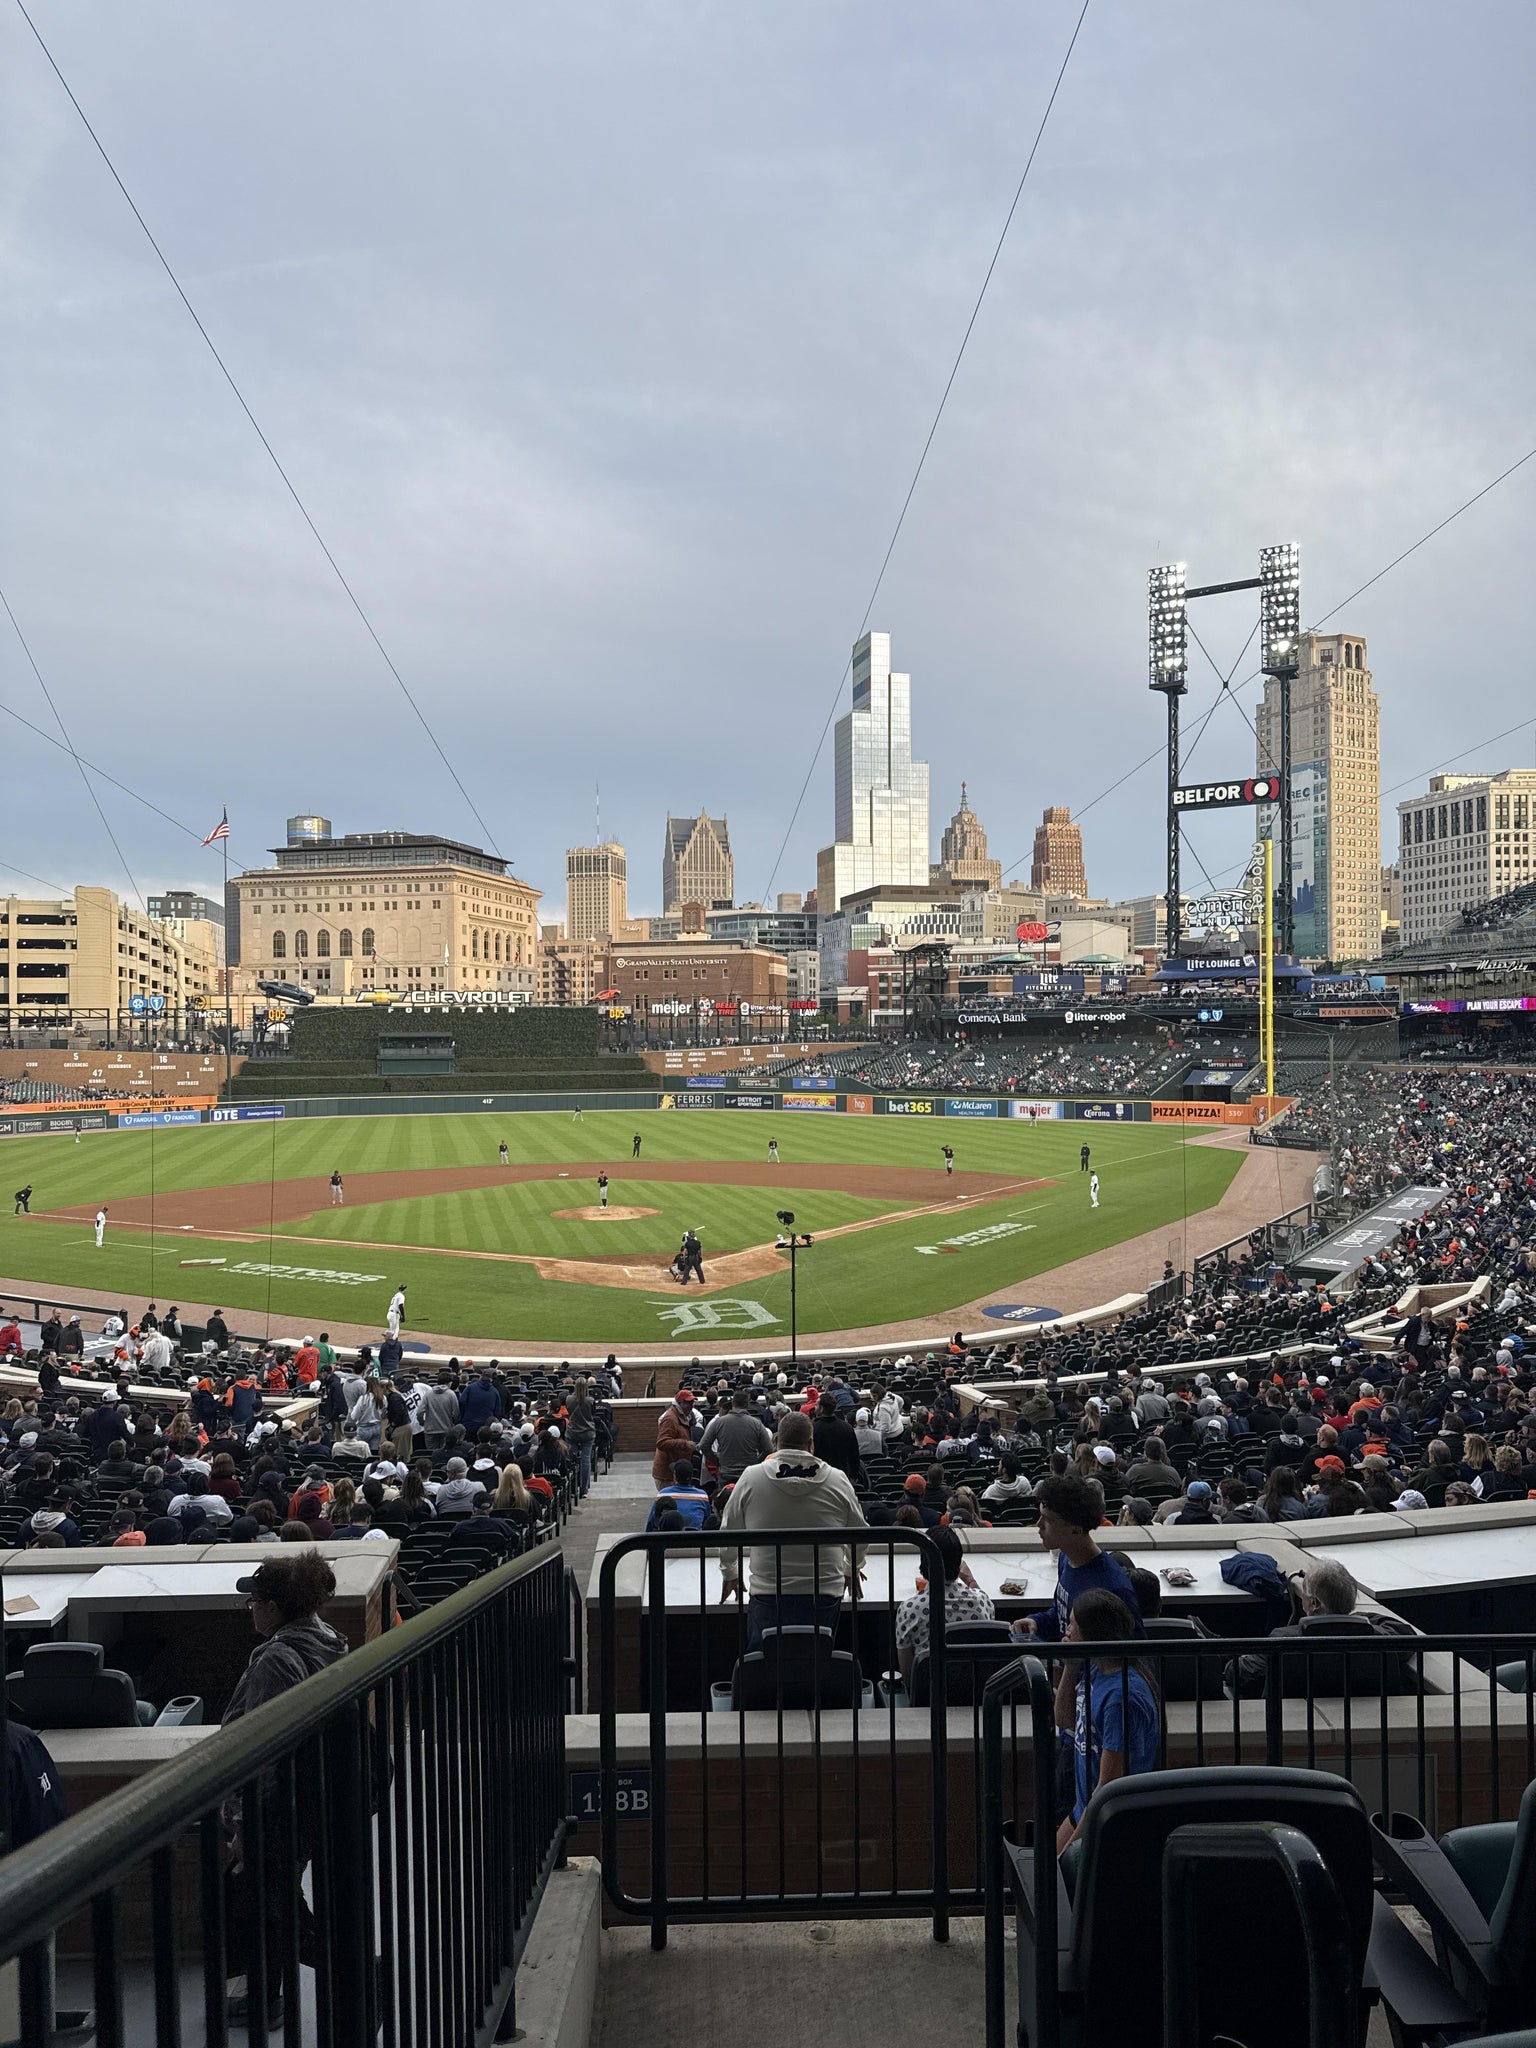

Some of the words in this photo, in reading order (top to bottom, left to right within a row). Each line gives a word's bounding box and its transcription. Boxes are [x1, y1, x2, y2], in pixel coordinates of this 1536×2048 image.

[1173, 785, 1241, 805] BELFOR
[1186, 959, 1206, 971] Lite
[1206, 959, 1241, 968] LOUNGE
[1040, 973, 1058, 985] Lite
[411, 990, 534, 1004] CHEVROLET
[651, 1000, 692, 1017] meijer
[1466, 1002, 1482, 1011] PLAN
[1483, 1001, 1499, 1010] YOUR
[1499, 1000, 1523, 1009] ESCAPE
[800, 1008, 818, 1016] LAW
[1003, 1013, 1027, 1022] Bank
[117, 1054, 122, 1062] 2
[159, 1055, 168, 1063] 16
[204, 1057, 210, 1065] 6
[92, 1069, 103, 1077] 47
[138, 1070, 144, 1078] 3
[677, 1095, 713, 1104] FERRIS
[889, 1101, 932, 1113] bet365
[962, 1101, 992, 1110] McLaren
[213, 1109, 239, 1121] DTE
[1084, 1109, 1111, 1118] Corona
[1153, 1107, 1185, 1117] PIZZA!
[1187, 1107, 1221, 1118] PIZZA!
[232, 1262, 388, 1282] VICTORS
[582, 1789, 649, 1813] 18B
